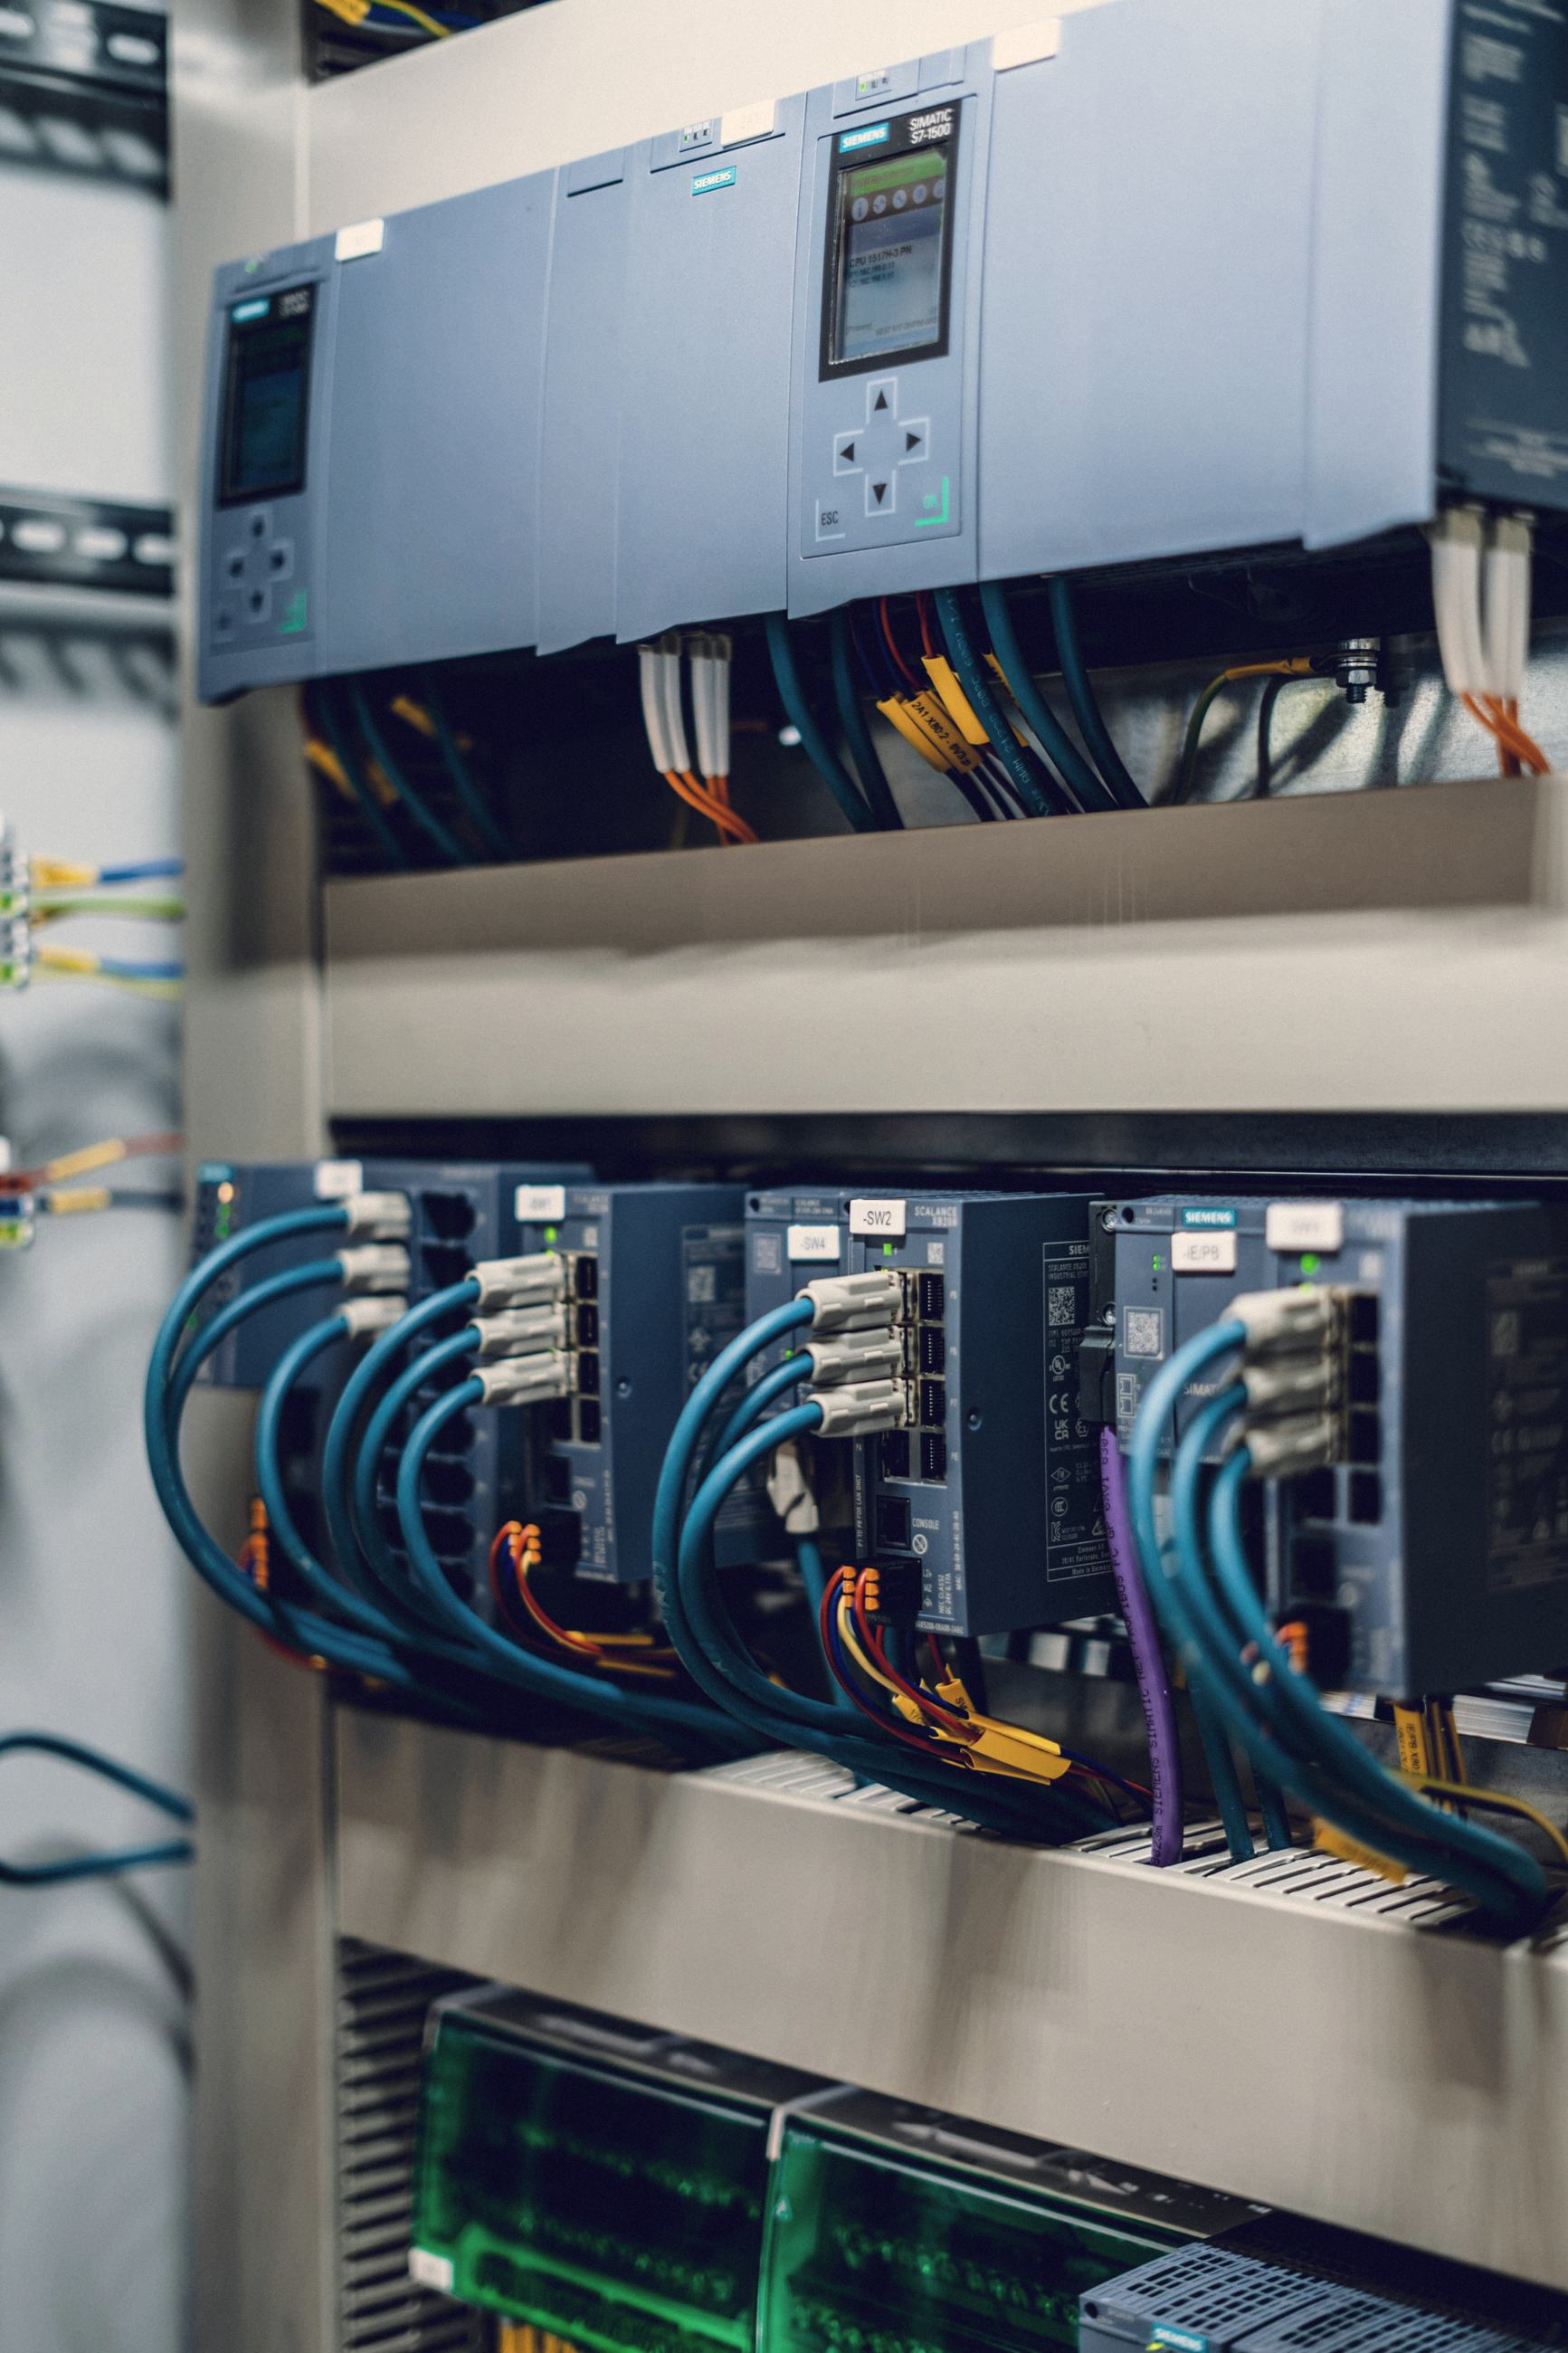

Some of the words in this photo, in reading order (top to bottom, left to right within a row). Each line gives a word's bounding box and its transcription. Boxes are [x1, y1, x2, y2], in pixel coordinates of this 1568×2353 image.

[909, 109, 953, 131] SIMATIC
[842, 128, 886, 148] SIEMENS
[910, 125, 951, 144] S7-1500
[693, 171, 732, 190] SIEMENS
[850, 256, 867, 268] CPU
[900, 245, 912, 254] PN
[821, 511, 839, 526] ESC
[863, 1211, 891, 1226] -SW2
[914, 1205, 957, 1217] SCALANCE
[1185, 1211, 1232, 1224] SIEMENS
[800, 1237, 825, 1251] -SW4
[1050, 1394, 1069, 1414] CE
[912, 1518, 939, 1530] CONSOLE
[1141, 1688, 1157, 1748] SIMATIC
[1152, 1758, 1163, 1815] SIEMENS
